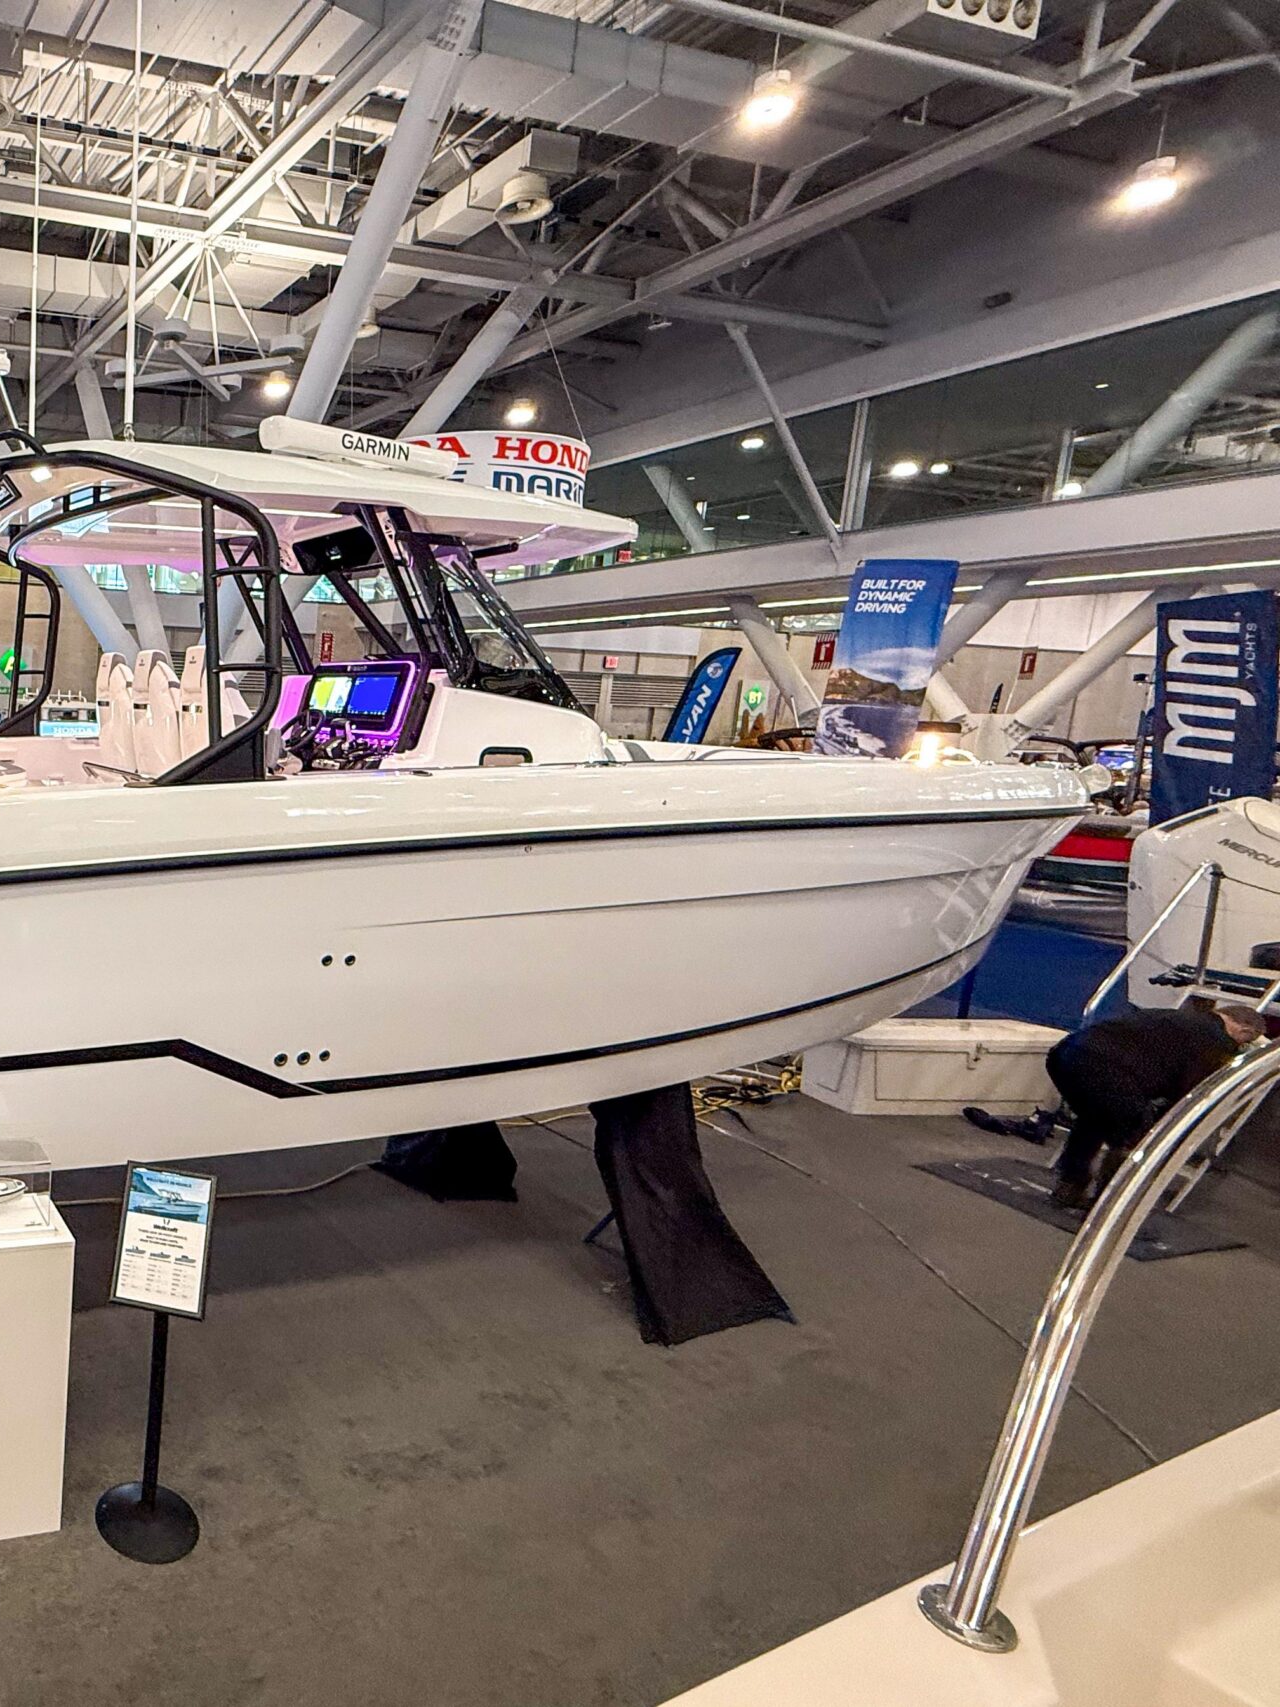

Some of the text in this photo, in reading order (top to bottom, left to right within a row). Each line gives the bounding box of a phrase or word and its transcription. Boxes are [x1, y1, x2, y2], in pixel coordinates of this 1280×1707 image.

[342, 433, 410, 461] GARMIN
[861, 579, 926, 591] BUILT FOR
[858, 591, 916, 602] DYNAMIC
[854, 602, 907, 614] DRIVING
[1245, 622, 1258, 679] YACHTS
[682, 684, 714, 744] VAN
